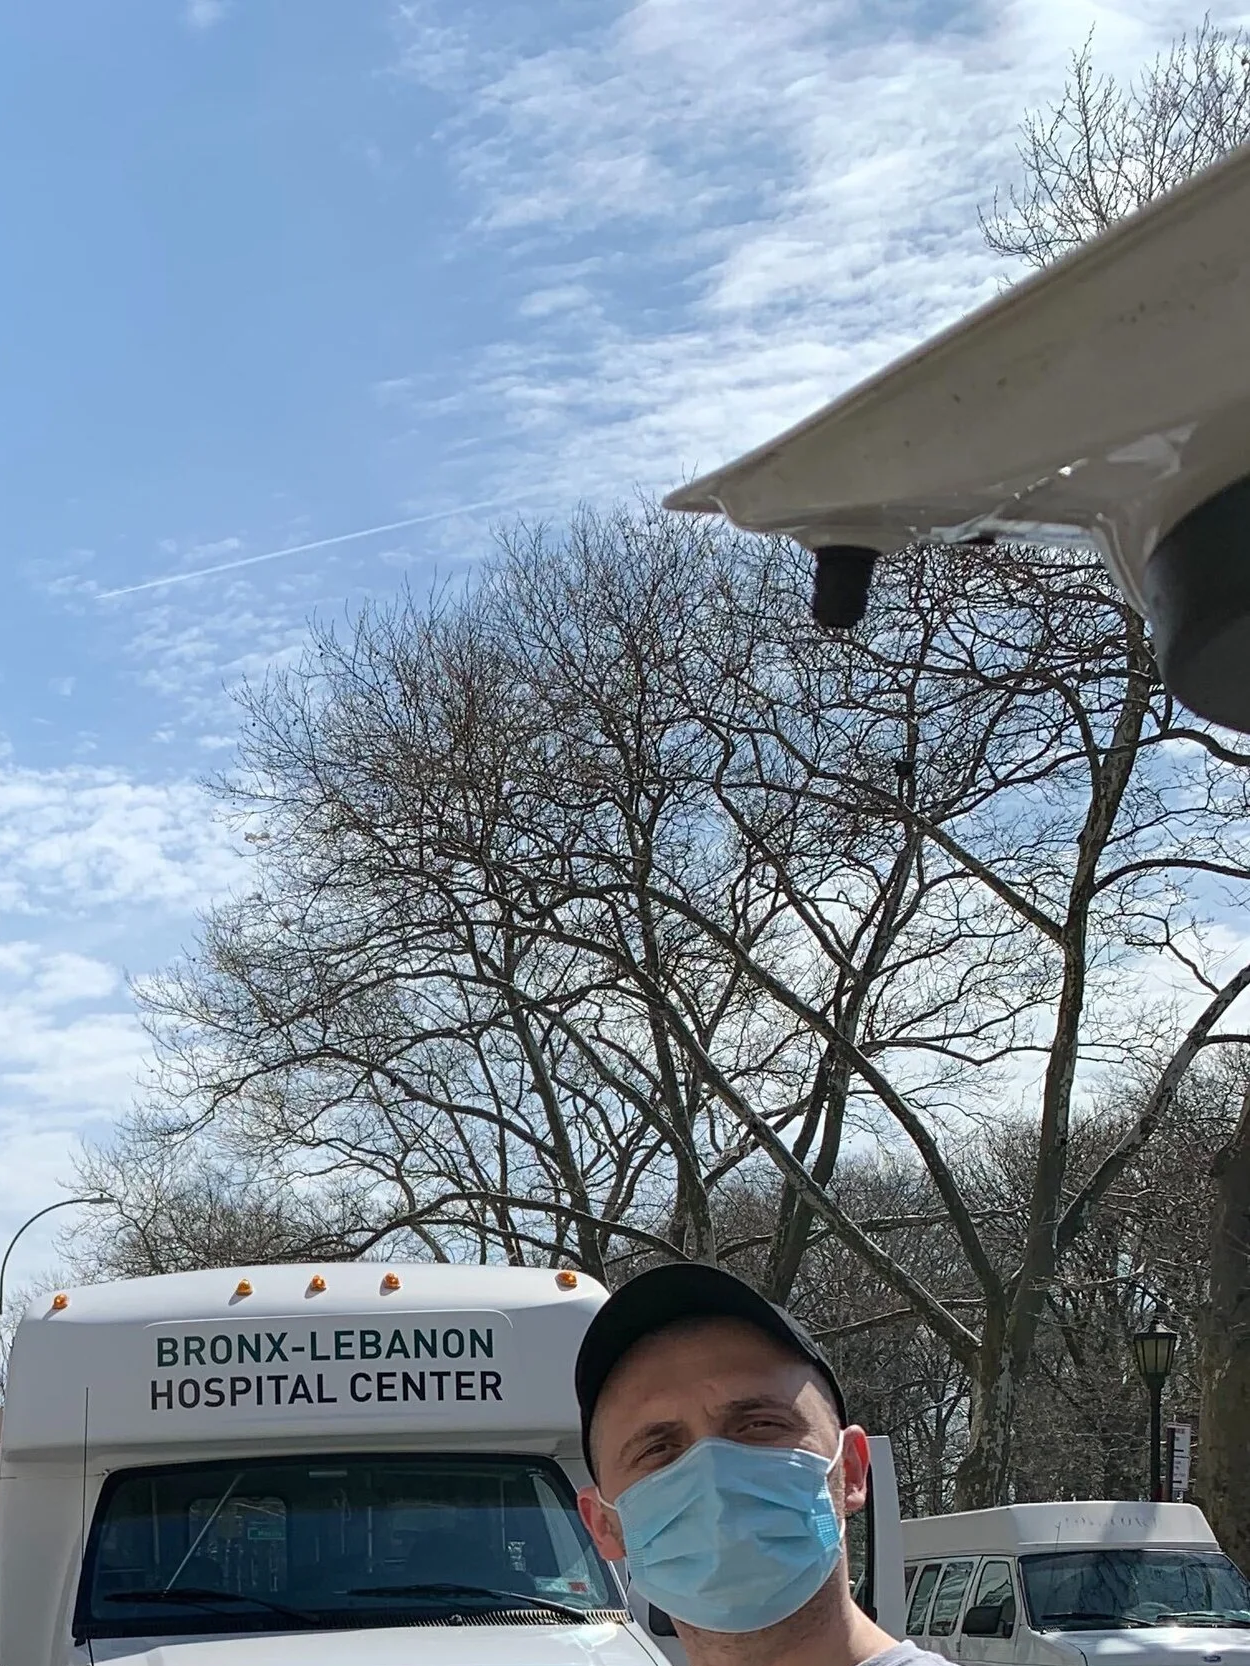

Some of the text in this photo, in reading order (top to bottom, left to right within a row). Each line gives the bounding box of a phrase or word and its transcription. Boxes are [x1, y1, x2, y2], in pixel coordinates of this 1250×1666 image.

[156, 1328, 494, 1367] BRONX-LEBANON
[151, 1370, 503, 1410] HOSPITAL CENTER
